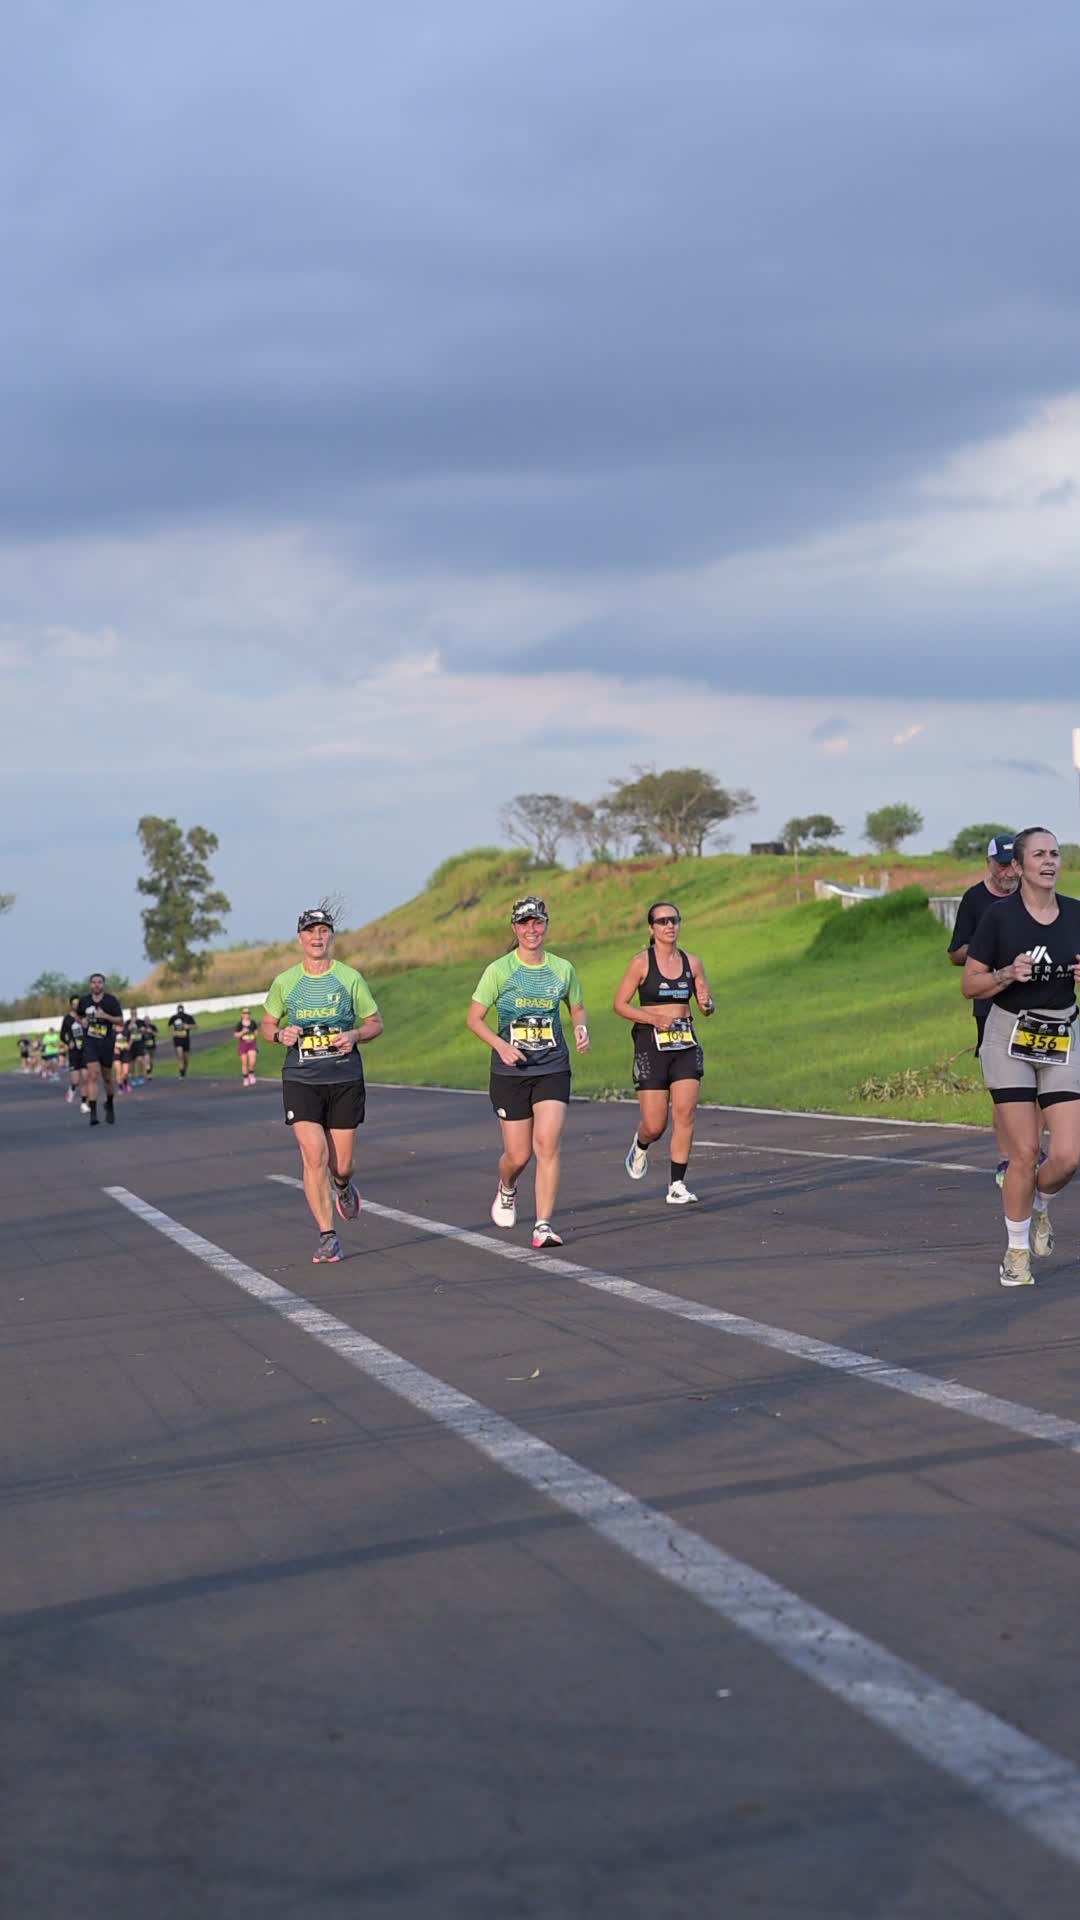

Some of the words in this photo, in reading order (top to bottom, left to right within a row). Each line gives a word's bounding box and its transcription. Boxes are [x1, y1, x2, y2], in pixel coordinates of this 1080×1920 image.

[515, 997, 554, 1009] BRASIL
[296, 1007, 337, 1019] BRASIL
[524, 1027, 542, 1039] 132
[310, 1035, 331, 1048] 133
[1025, 1034, 1057, 1050] 356
